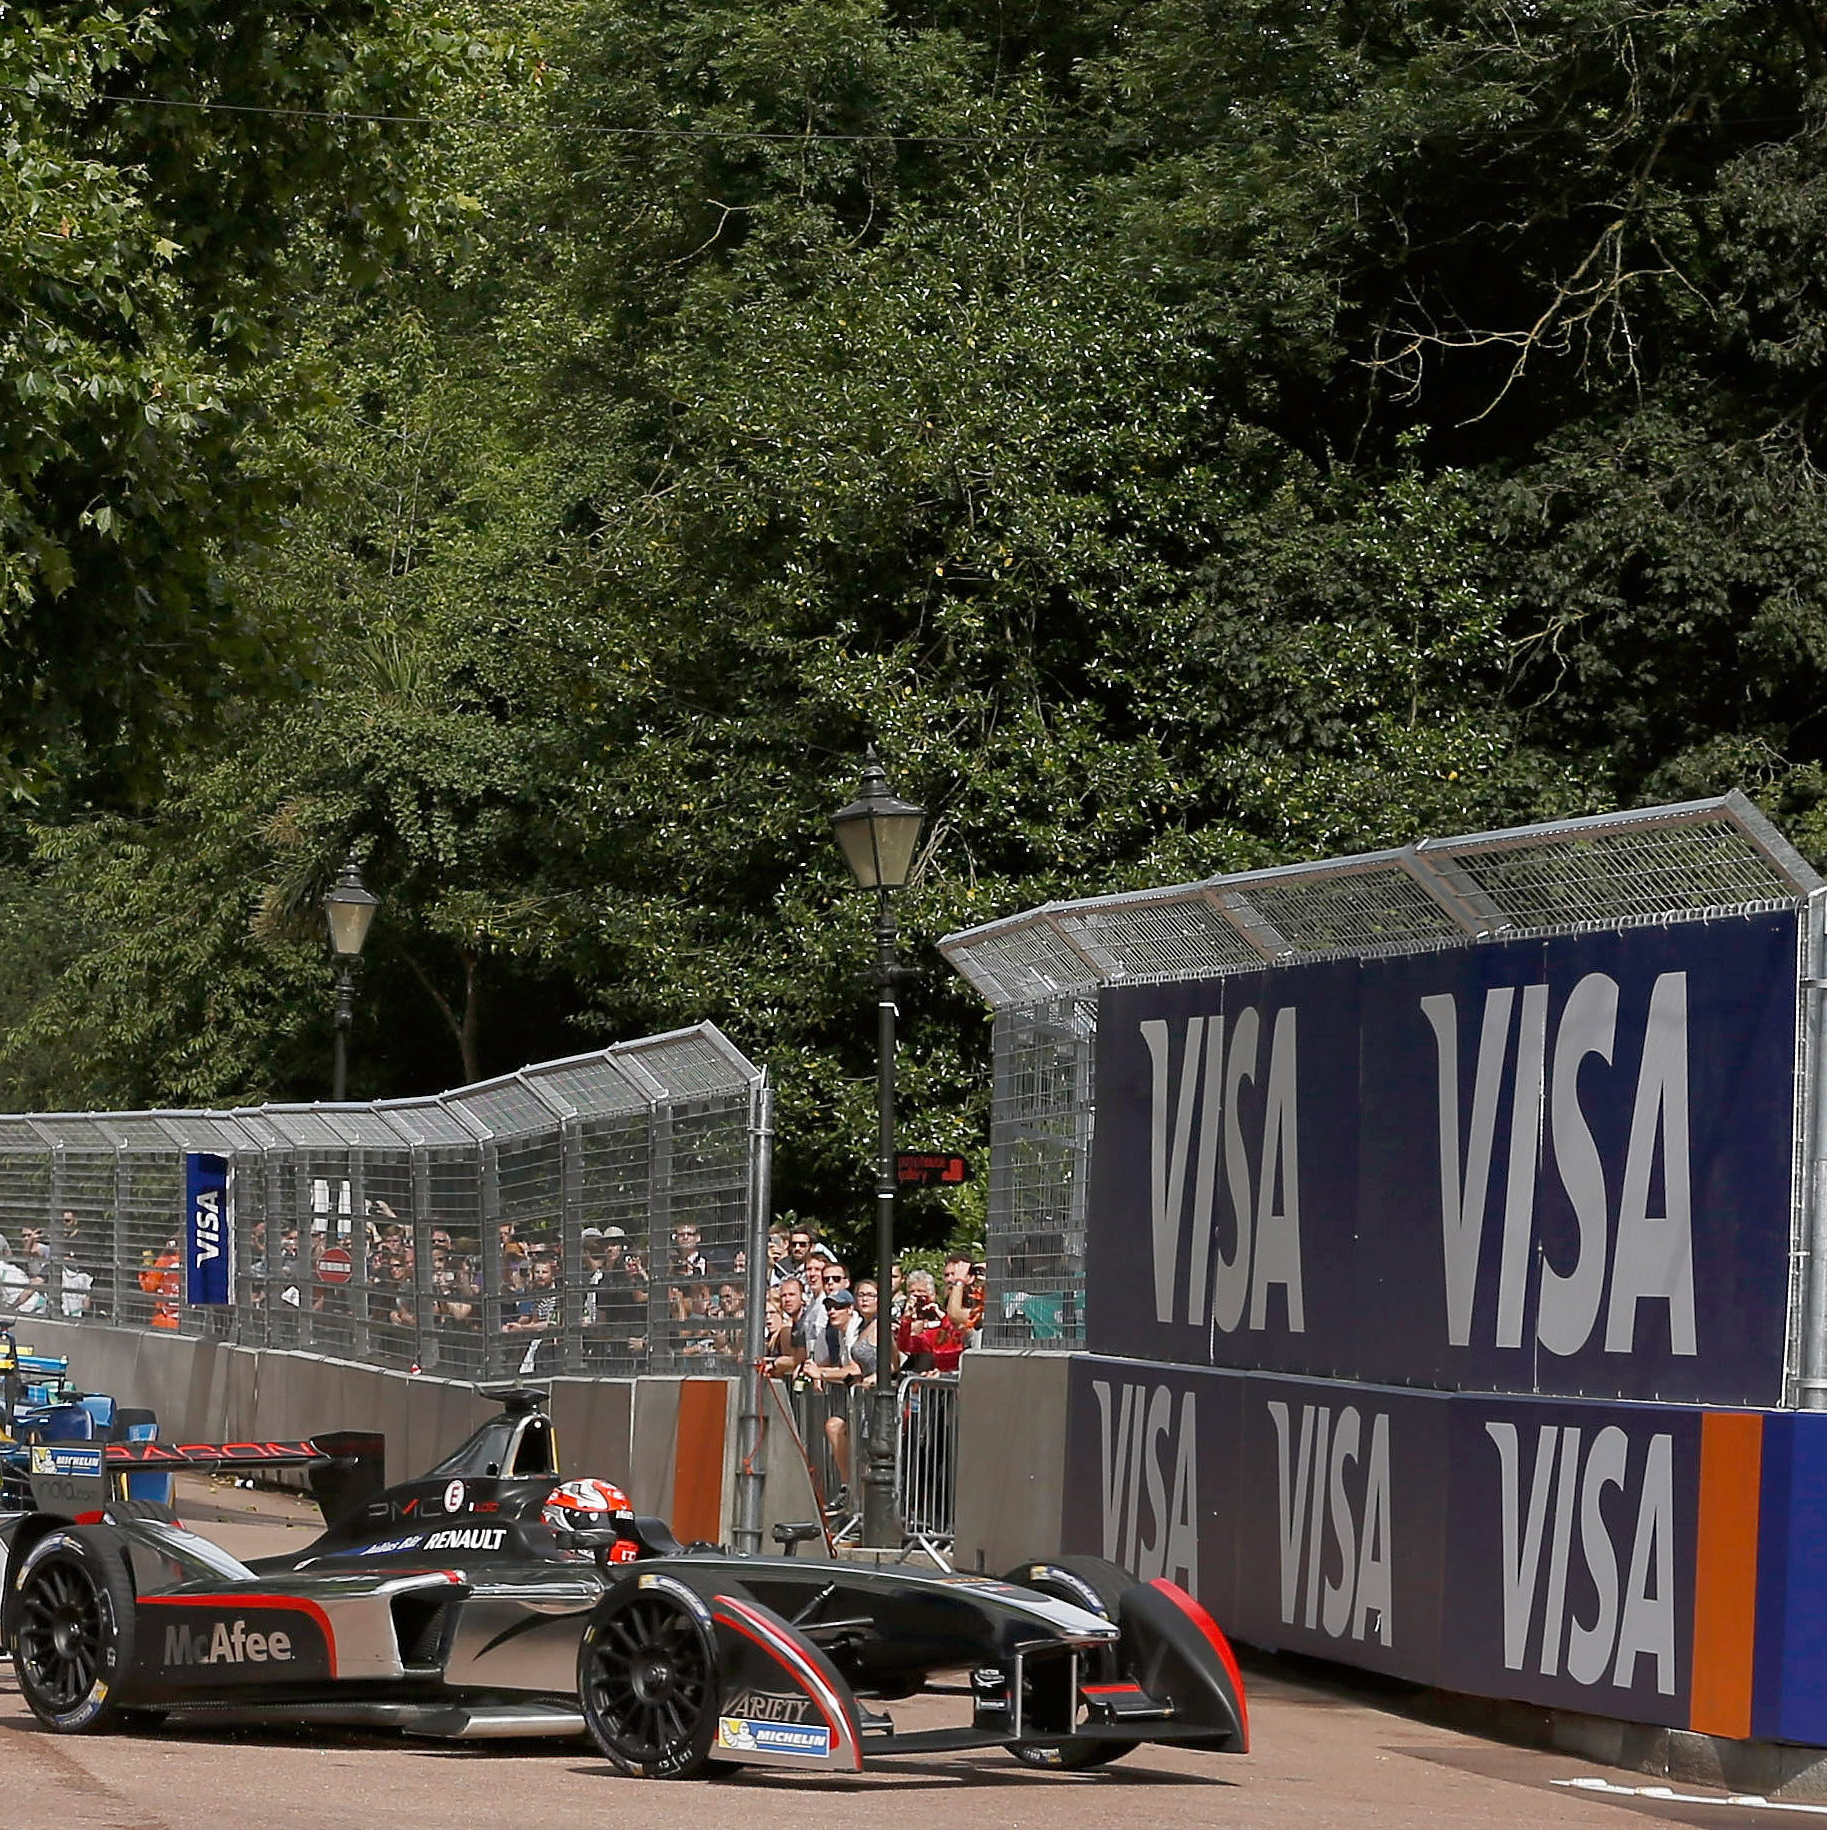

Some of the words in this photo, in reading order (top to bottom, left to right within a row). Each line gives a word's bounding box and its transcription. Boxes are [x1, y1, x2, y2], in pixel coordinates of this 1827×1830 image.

[1139, 1005, 1305, 1333] VISA
[1420, 971, 1698, 1357] VISA
[196, 1190, 220, 1269] VISA
[56, 1455, 100, 1467] MICHELIN
[106, 1441, 316, 1461] RAGON
[1093, 1381, 1200, 1597] VISA
[422, 1528, 508, 1550] RENAULT
[1267, 1400, 1393, 1648] VISA
[1484, 1420, 1676, 1695] VISA
[164, 1619, 292, 1666] McAfee
[756, 1729, 827, 1747] MICHELIN
